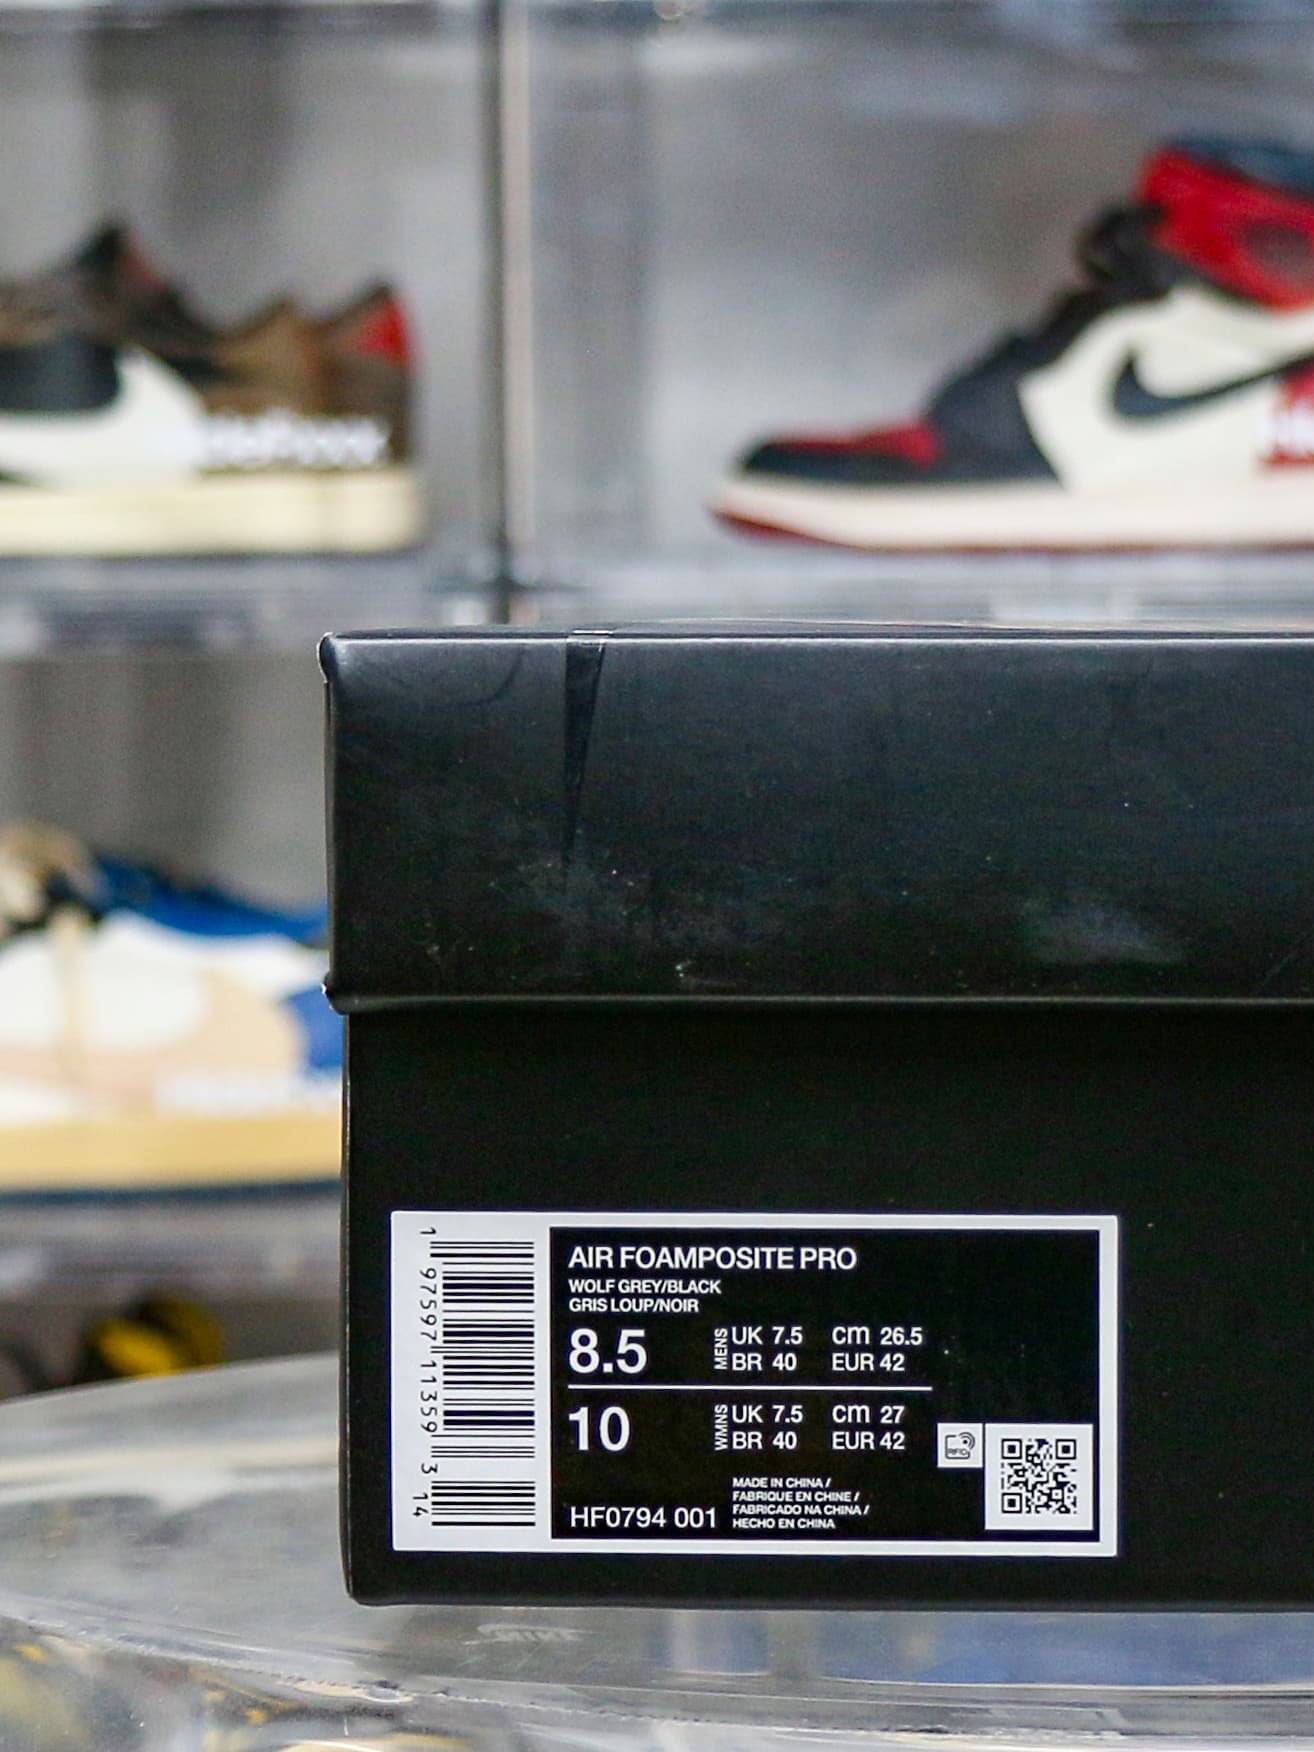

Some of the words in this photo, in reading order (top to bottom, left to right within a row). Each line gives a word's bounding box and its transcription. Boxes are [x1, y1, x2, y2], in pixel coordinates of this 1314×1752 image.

[568, 1246, 614, 1269] AIR
[620, 1246, 795, 1270] FOAMPOSITE
[800, 1247, 858, 1270] PRO
[568, 1279, 616, 1294] WOLF
[618, 1279, 722, 1295] GREY/BLACK
[420, 1268, 437, 1341] 97597
[568, 1298, 608, 1312] GRIS
[611, 1298, 699, 1313] LOUP/NOIR
[732, 1326, 763, 1345] UK
[772, 1326, 803, 1345] 7.5
[880, 1326, 923, 1346] 26.5
[569, 1328, 647, 1374] 8.5
[714, 1328, 729, 1370] MENS
[732, 1353, 763, 1371] BR
[772, 1353, 798, 1371] 40
[832, 1353, 875, 1372] EUR
[879, 1353, 905, 1372] 42
[420, 1360, 438, 1433] 11359
[732, 1405, 764, 1424] UK
[772, 1405, 804, 1424] 7.5
[880, 1406, 905, 1424] 27
[569, 1407, 630, 1451] 10
[714, 1404, 729, 1451] WMNS
[732, 1431, 763, 1450] BR
[772, 1431, 798, 1450] 40
[832, 1431, 875, 1450] EUR
[879, 1431, 906, 1450] 42
[732, 1477, 769, 1488] MADE
[770, 1477, 784, 1488] IN
[786, 1477, 823, 1488] CHINA
[413, 1492, 429, 1517] 14
[732, 1491, 793, 1502] FABRIQUE
[795, 1491, 812, 1502] EN
[814, 1491, 851, 1502] CHINE
[570, 1507, 667, 1529] HF0794
[674, 1508, 716, 1529] 001
[732, 1504, 802, 1515] FABRICADO
[804, 1504, 822, 1515] NA
[823, 1504, 862, 1515] CHINA
[732, 1518, 775, 1529] HECHO
[778, 1518, 794, 1529] EN
[796, 1518, 836, 1529] CHINA
